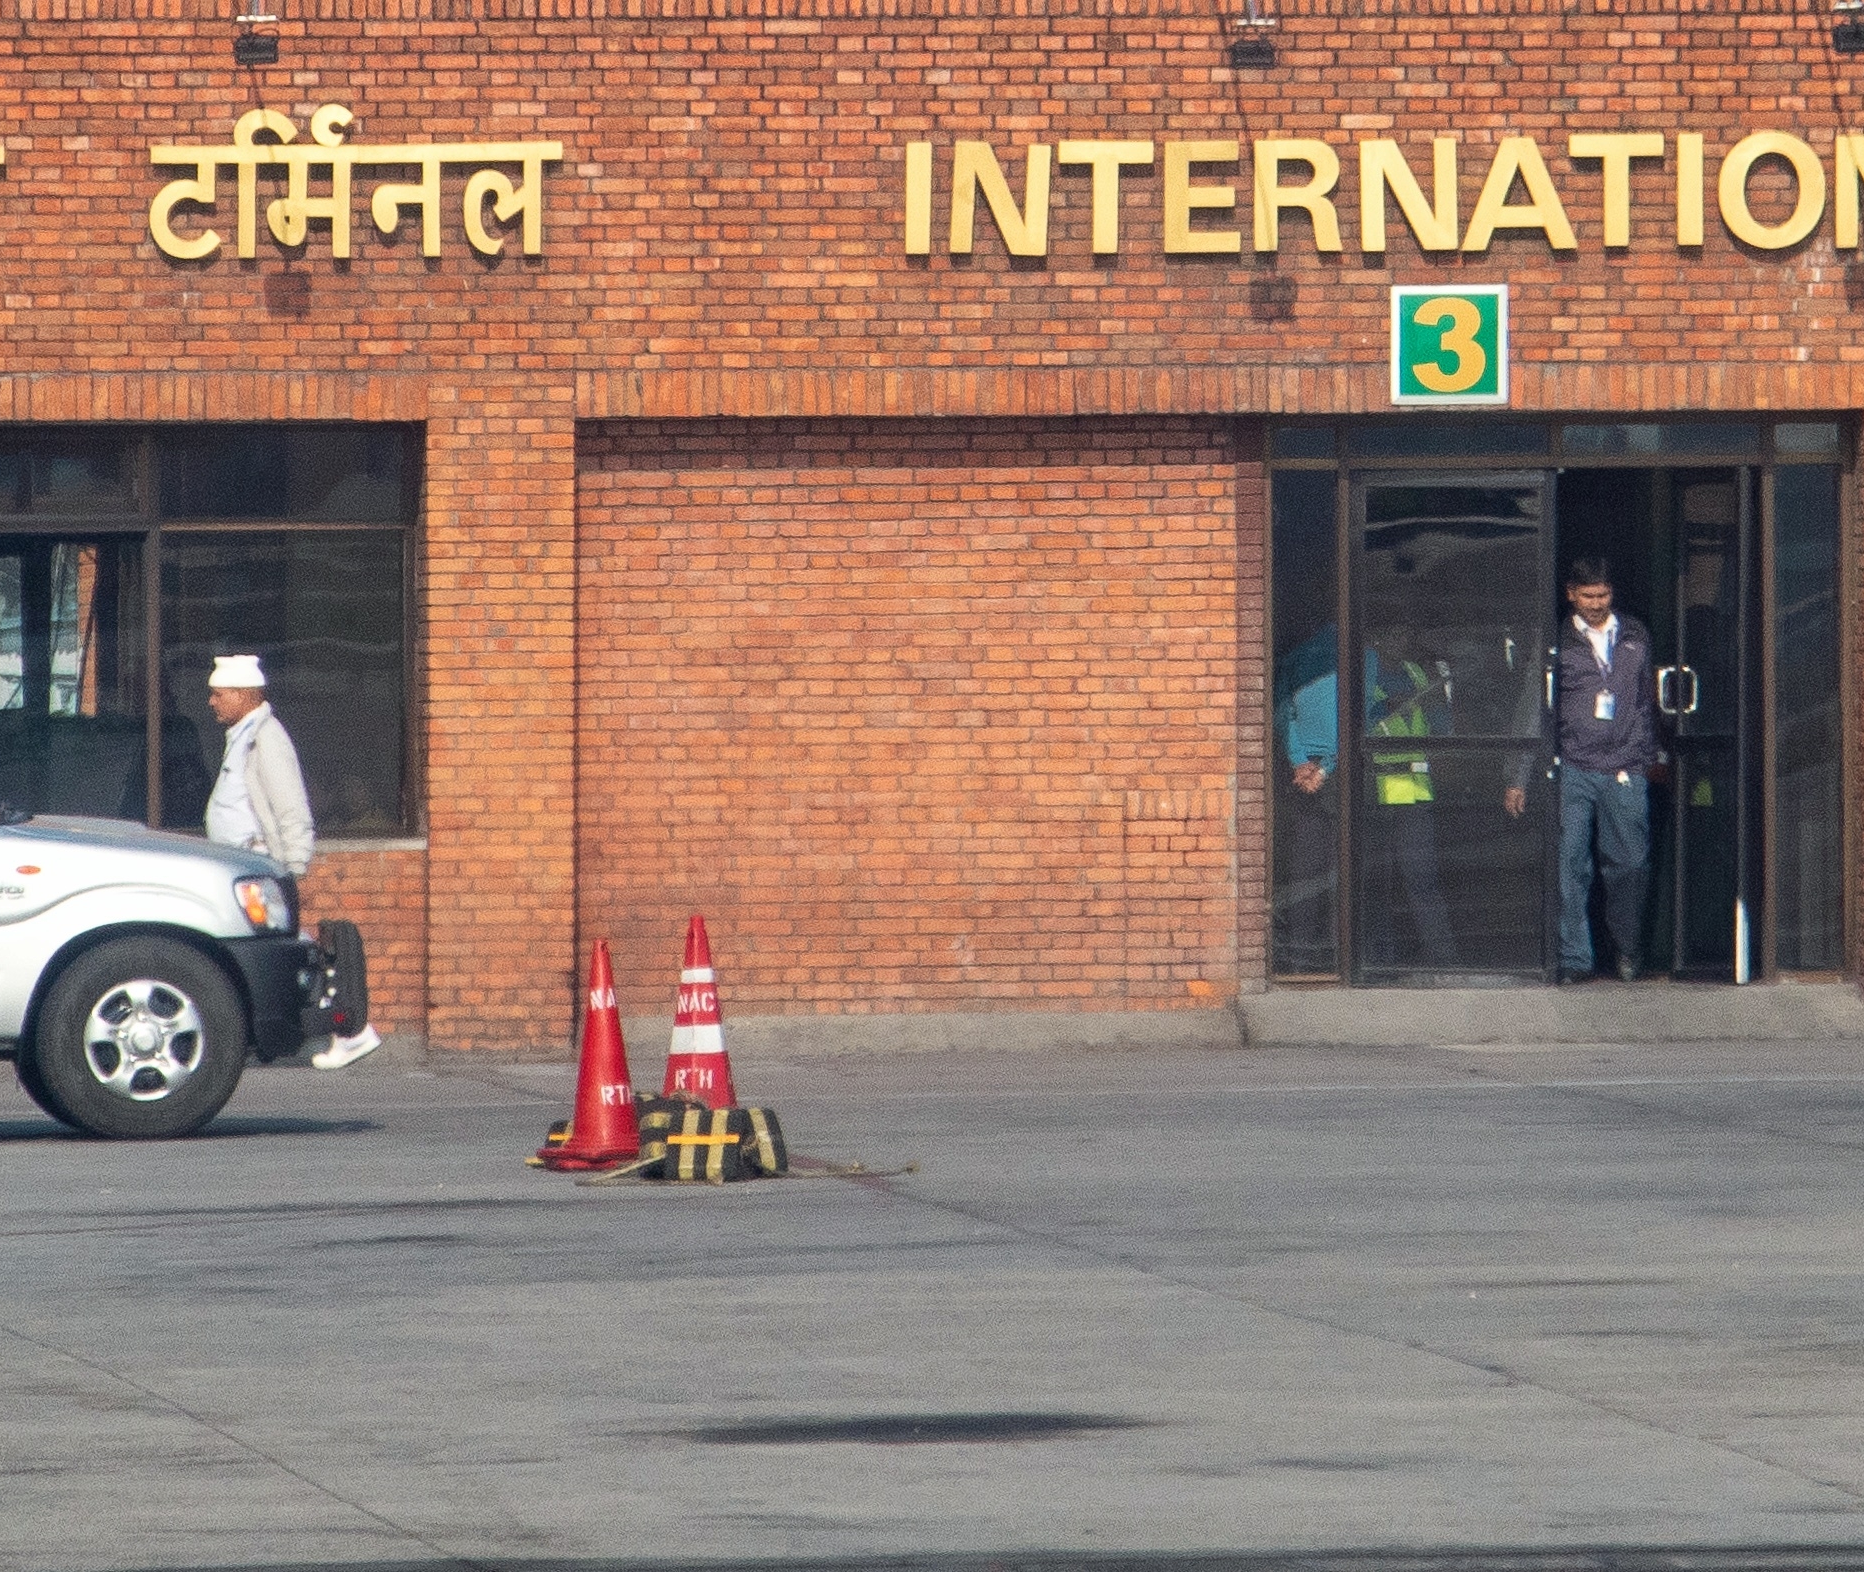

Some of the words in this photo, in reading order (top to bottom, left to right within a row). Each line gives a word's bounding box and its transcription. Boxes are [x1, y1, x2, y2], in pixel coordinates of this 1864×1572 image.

[149, 103, 565, 260] टर्मिनल
[1413, 299, 1485, 392] 3
[678, 991, 715, 1013] NAC
